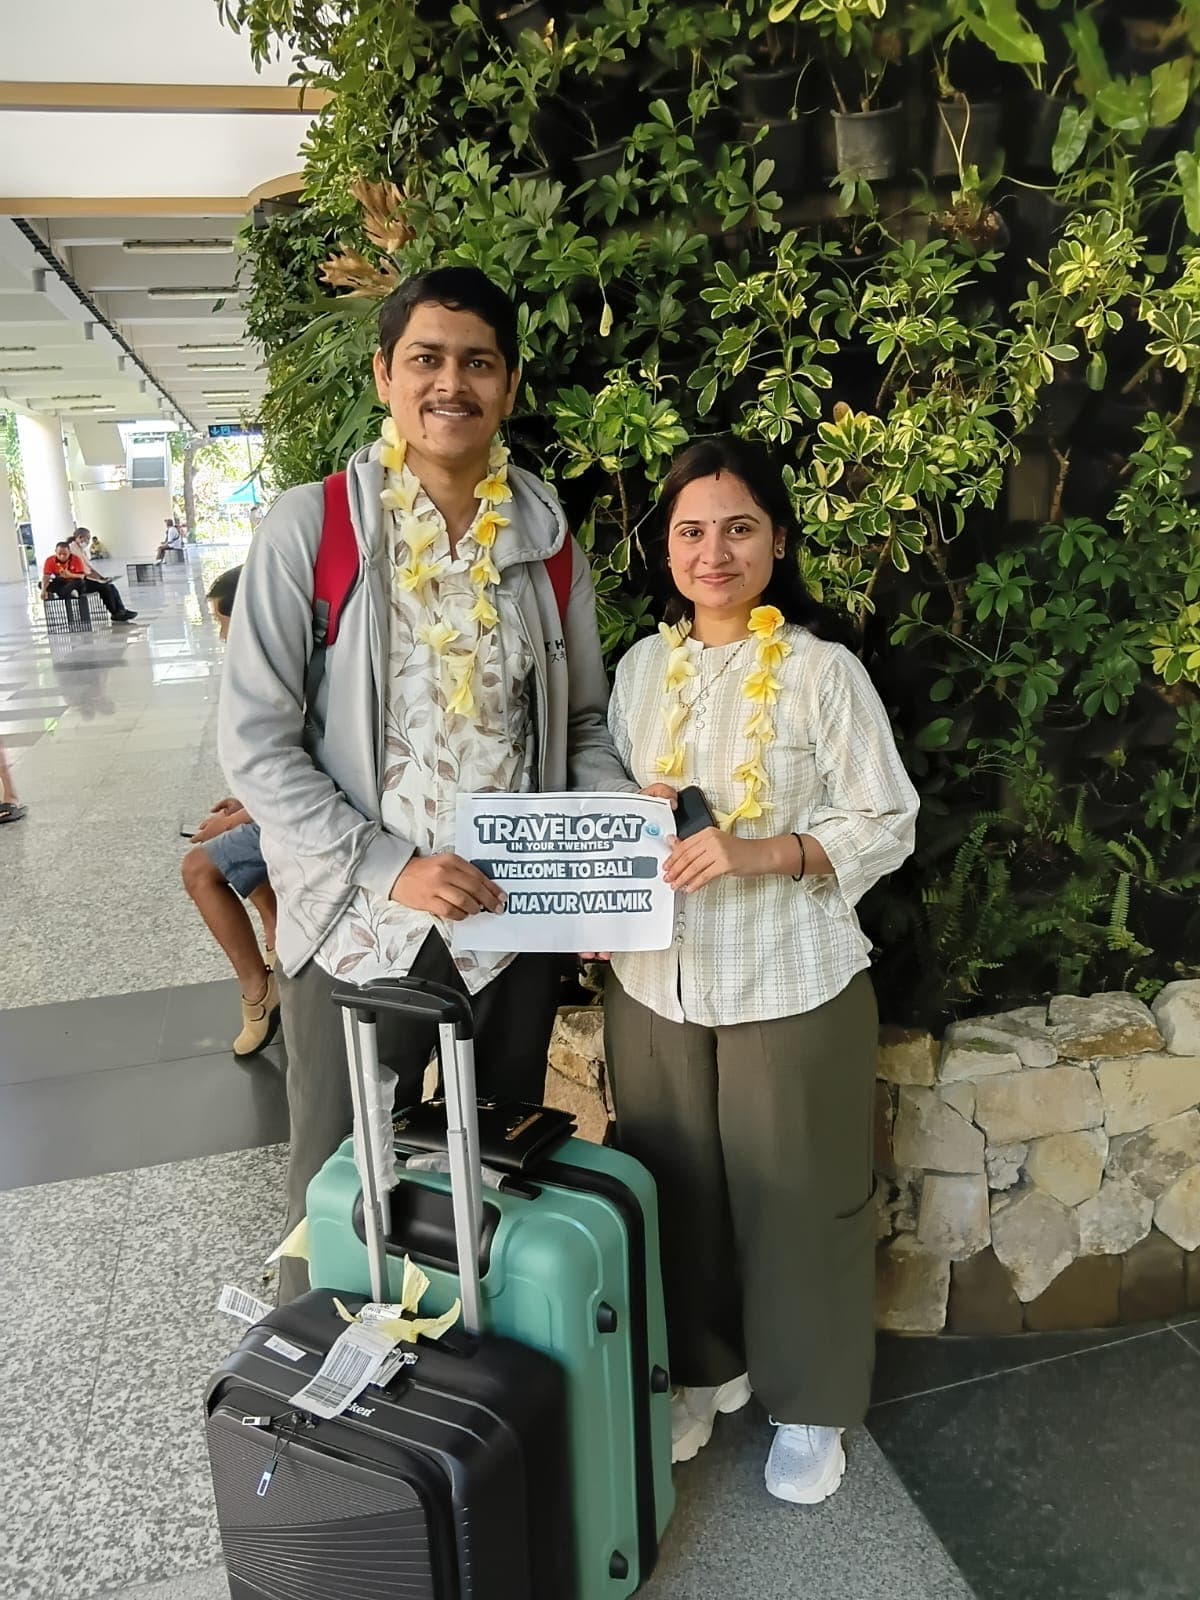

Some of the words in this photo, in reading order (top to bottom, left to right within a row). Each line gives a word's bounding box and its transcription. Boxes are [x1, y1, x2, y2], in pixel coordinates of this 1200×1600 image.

[476, 815, 643, 842] TRAVELOCAT
[511, 842, 521, 850] IN
[526, 842, 554, 851] YOUR
[557, 841, 610, 850] TWENTIES
[492, 863, 565, 878] WELCOME
[569, 863, 591, 878] TO
[594, 861, 633, 877] BALI
[509, 893, 578, 913] MAYUR
[580, 891, 652, 912] VALMIK
